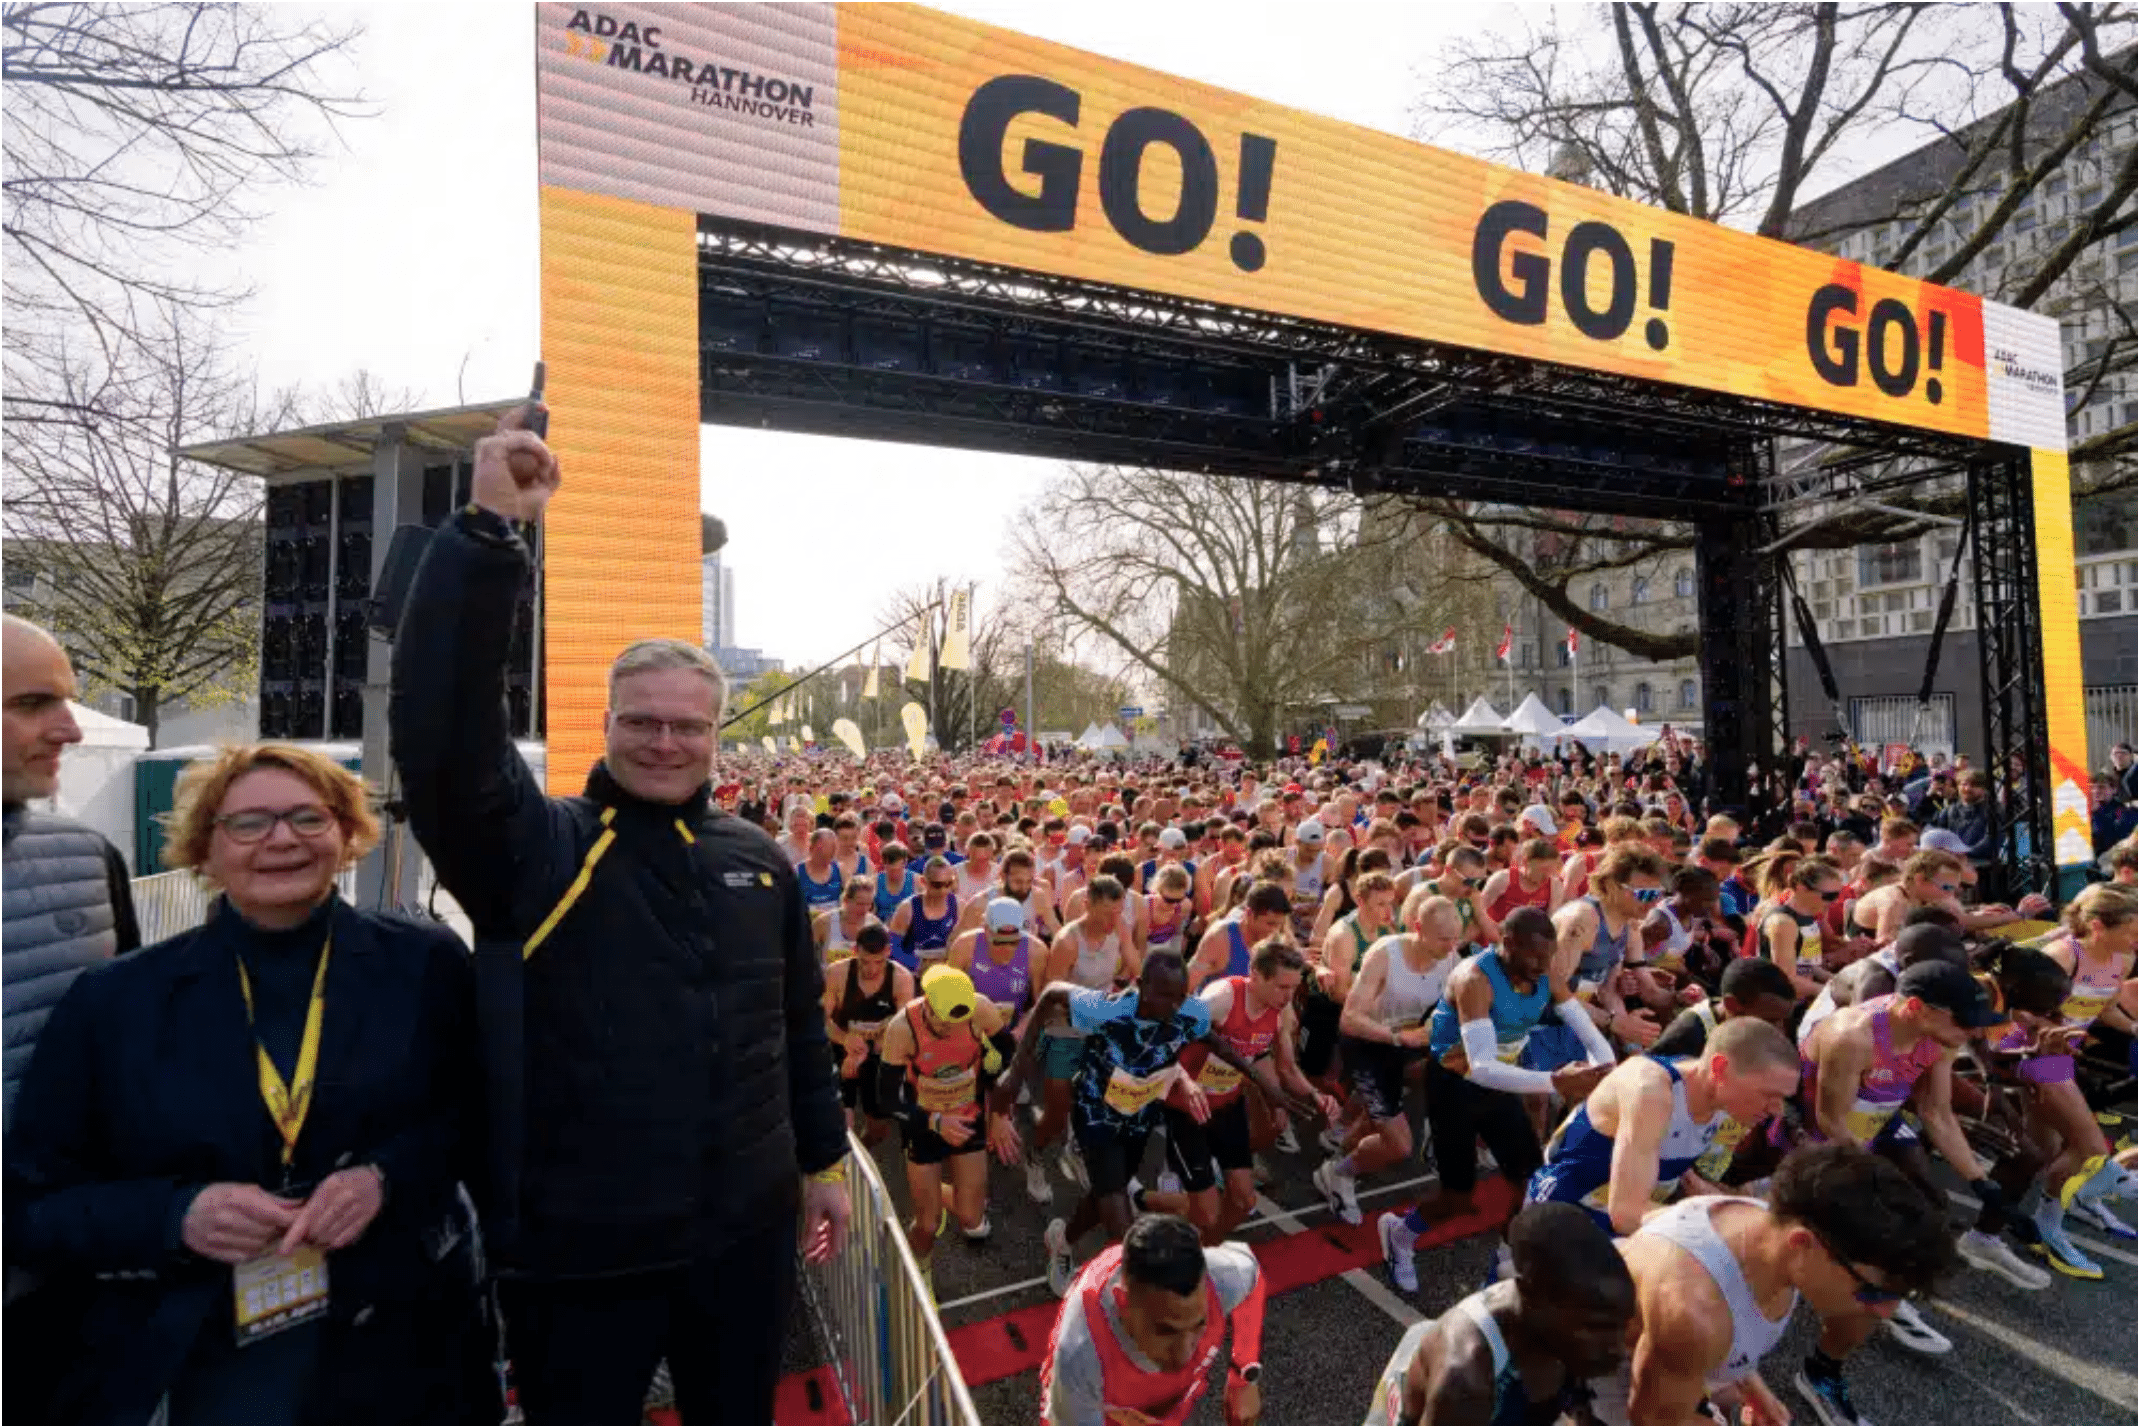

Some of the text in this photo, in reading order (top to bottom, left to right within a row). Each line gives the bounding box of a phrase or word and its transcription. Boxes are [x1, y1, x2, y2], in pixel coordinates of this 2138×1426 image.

[567, 10, 662, 48] ADAC
[607, 43, 814, 108] MARATHON
[690, 87, 815, 128] HANNOVER
[958, 74, 1946, 404] GO! GO! GO!
